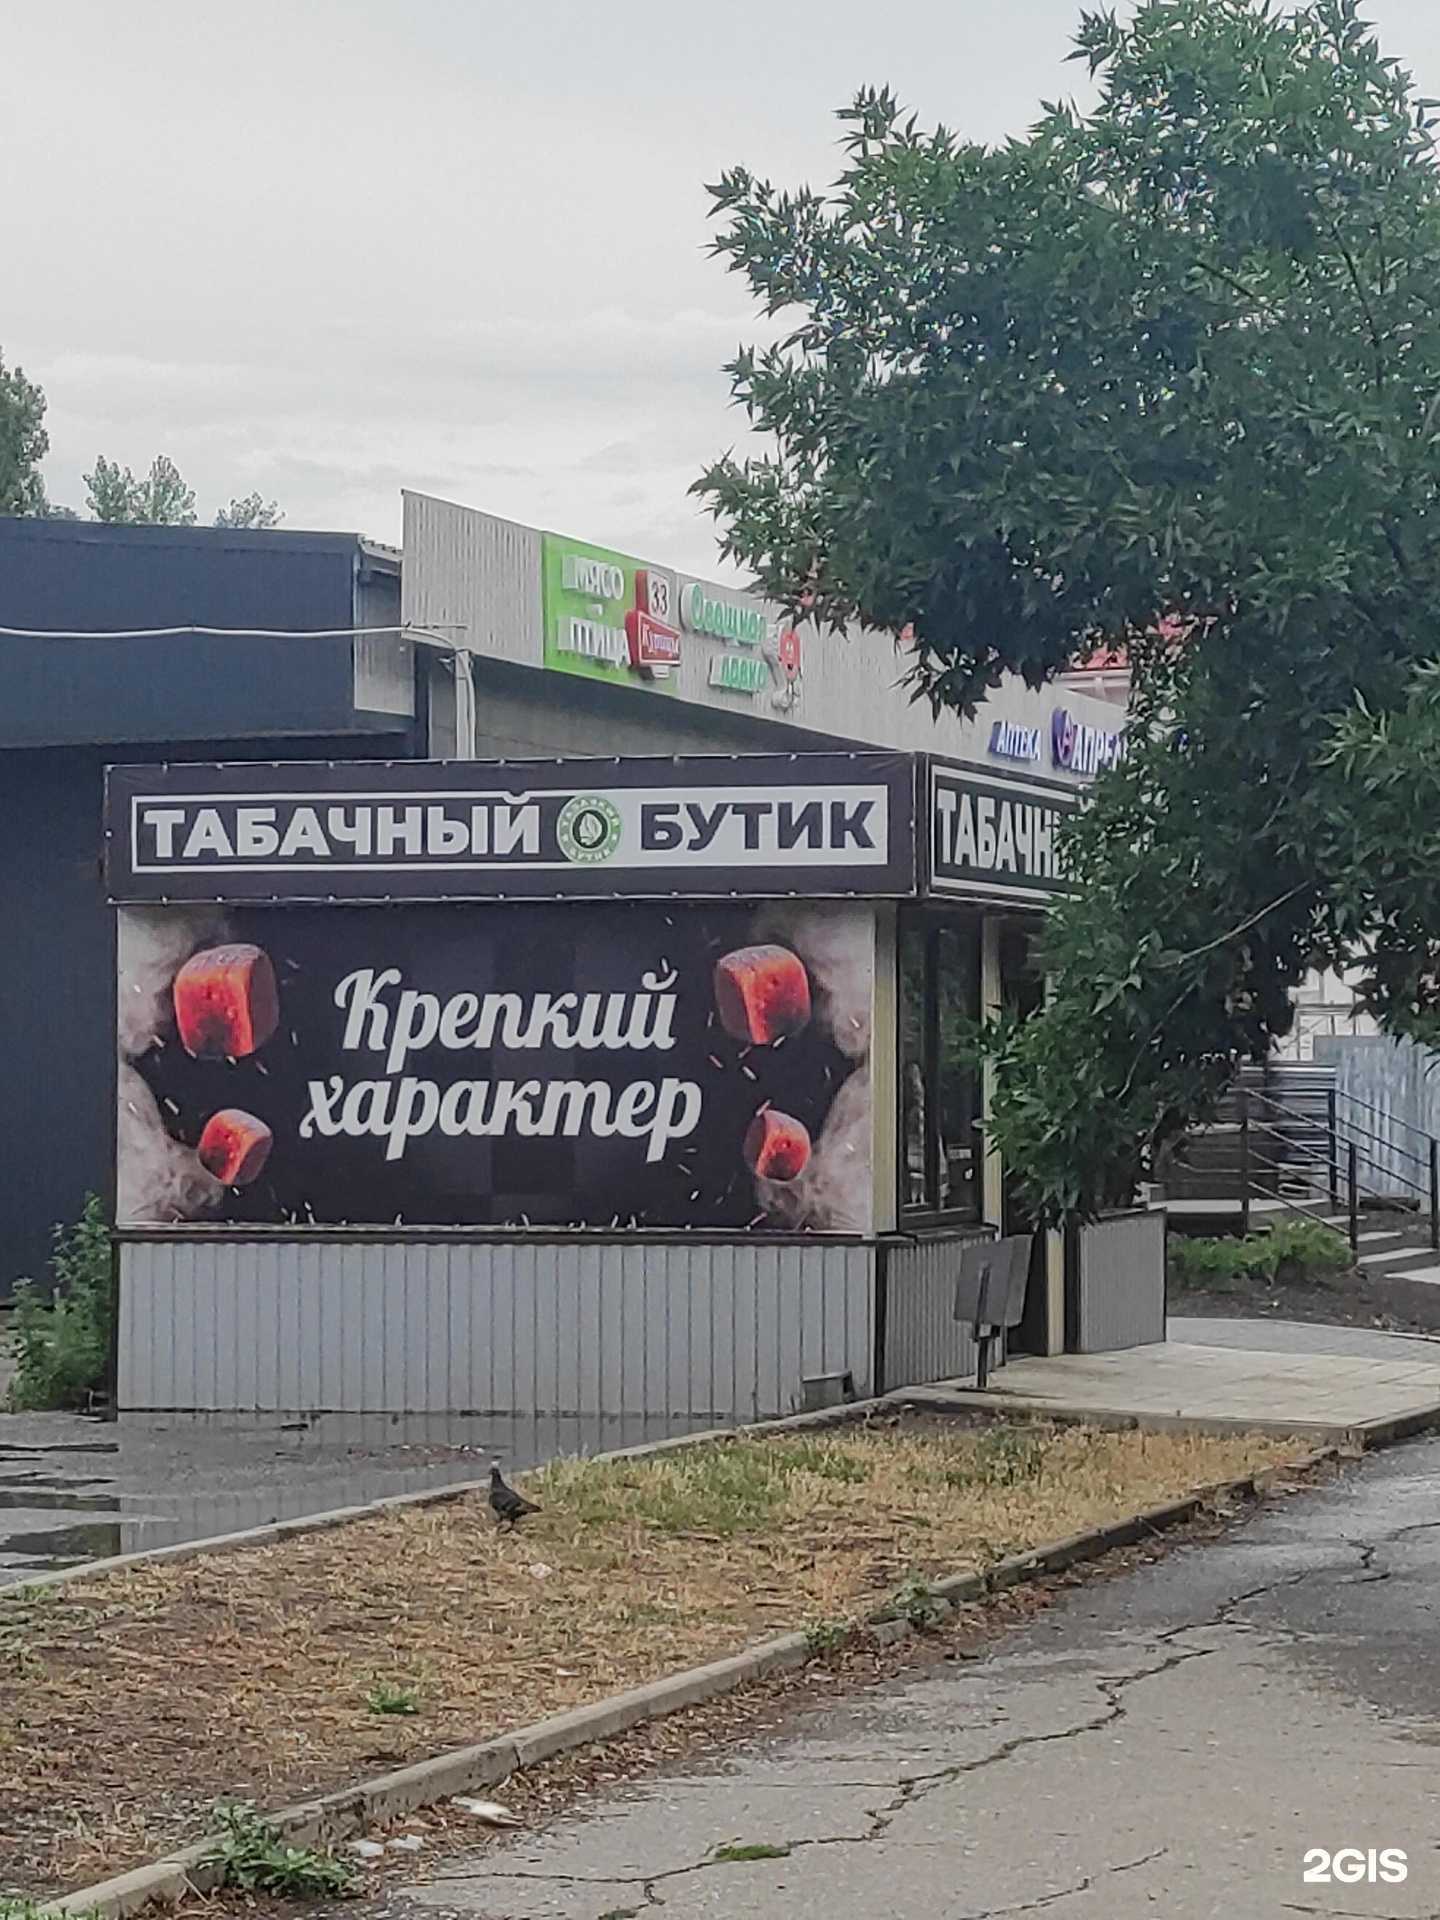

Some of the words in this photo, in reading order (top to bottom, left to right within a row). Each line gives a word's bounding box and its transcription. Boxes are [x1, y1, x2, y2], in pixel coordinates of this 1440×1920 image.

[572, 555, 624, 600] МЯСО
[651, 580, 668, 616] 33
[567, 616, 631, 668] ПТИЦА
[144, 793, 541, 858] ТАБАЧНЫЙ
[641, 801, 876, 851] БУТИК
[937, 788, 1085, 884] ТАБАЧН
[334, 968, 678, 1074] Крепкий
[300, 1075, 701, 1163] характер
